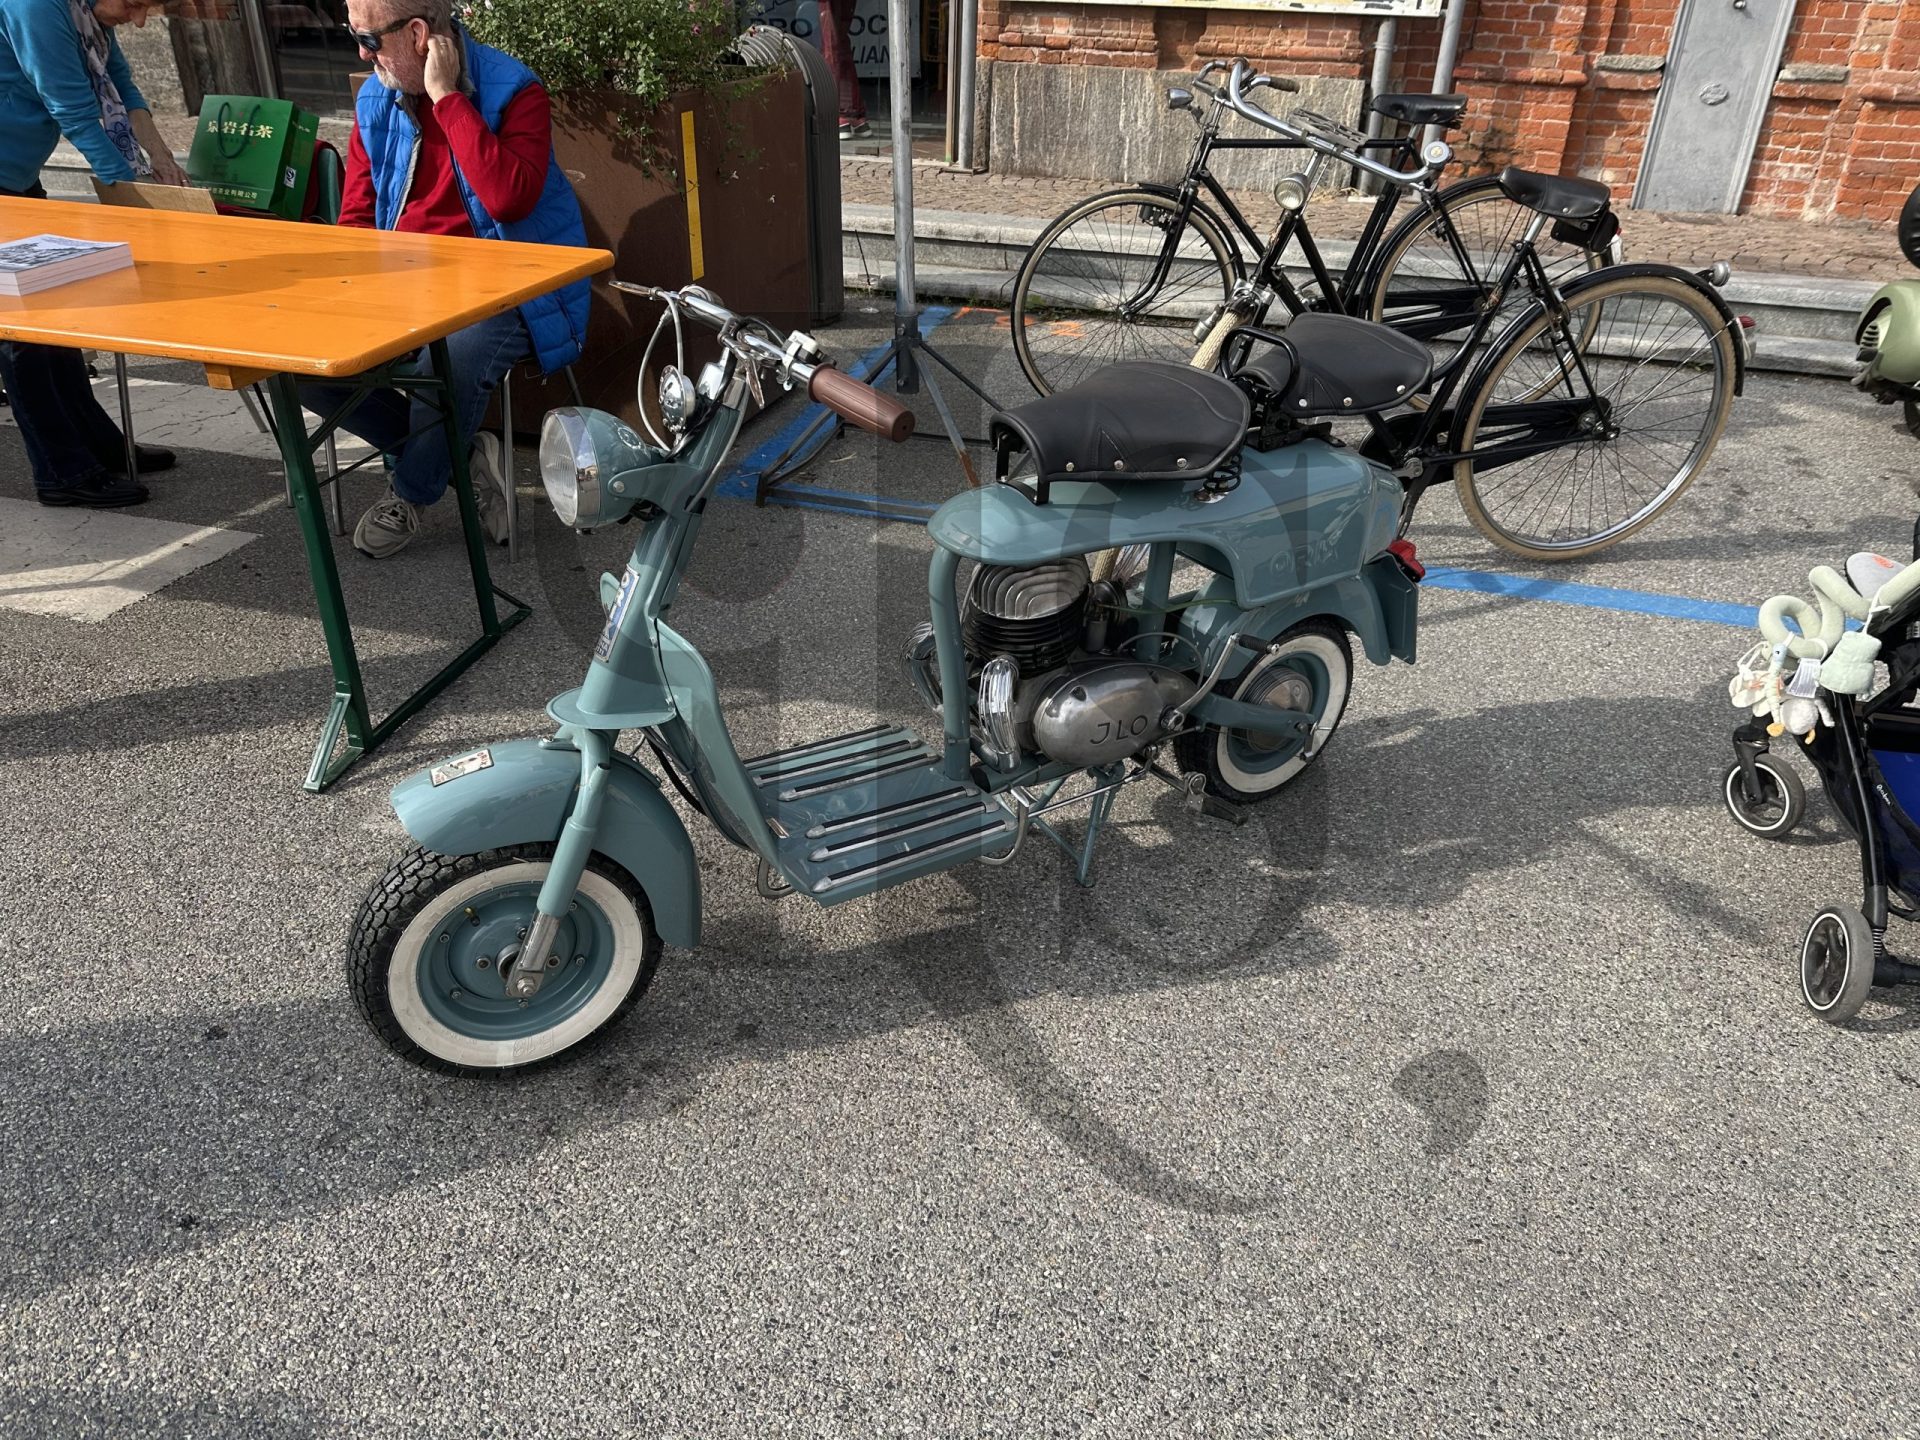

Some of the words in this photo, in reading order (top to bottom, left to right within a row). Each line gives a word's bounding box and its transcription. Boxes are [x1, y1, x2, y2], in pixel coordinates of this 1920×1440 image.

[847, 14, 912, 36] OC
[851, 45, 890, 64] LIAN
[1089, 714, 1149, 745] JLO
